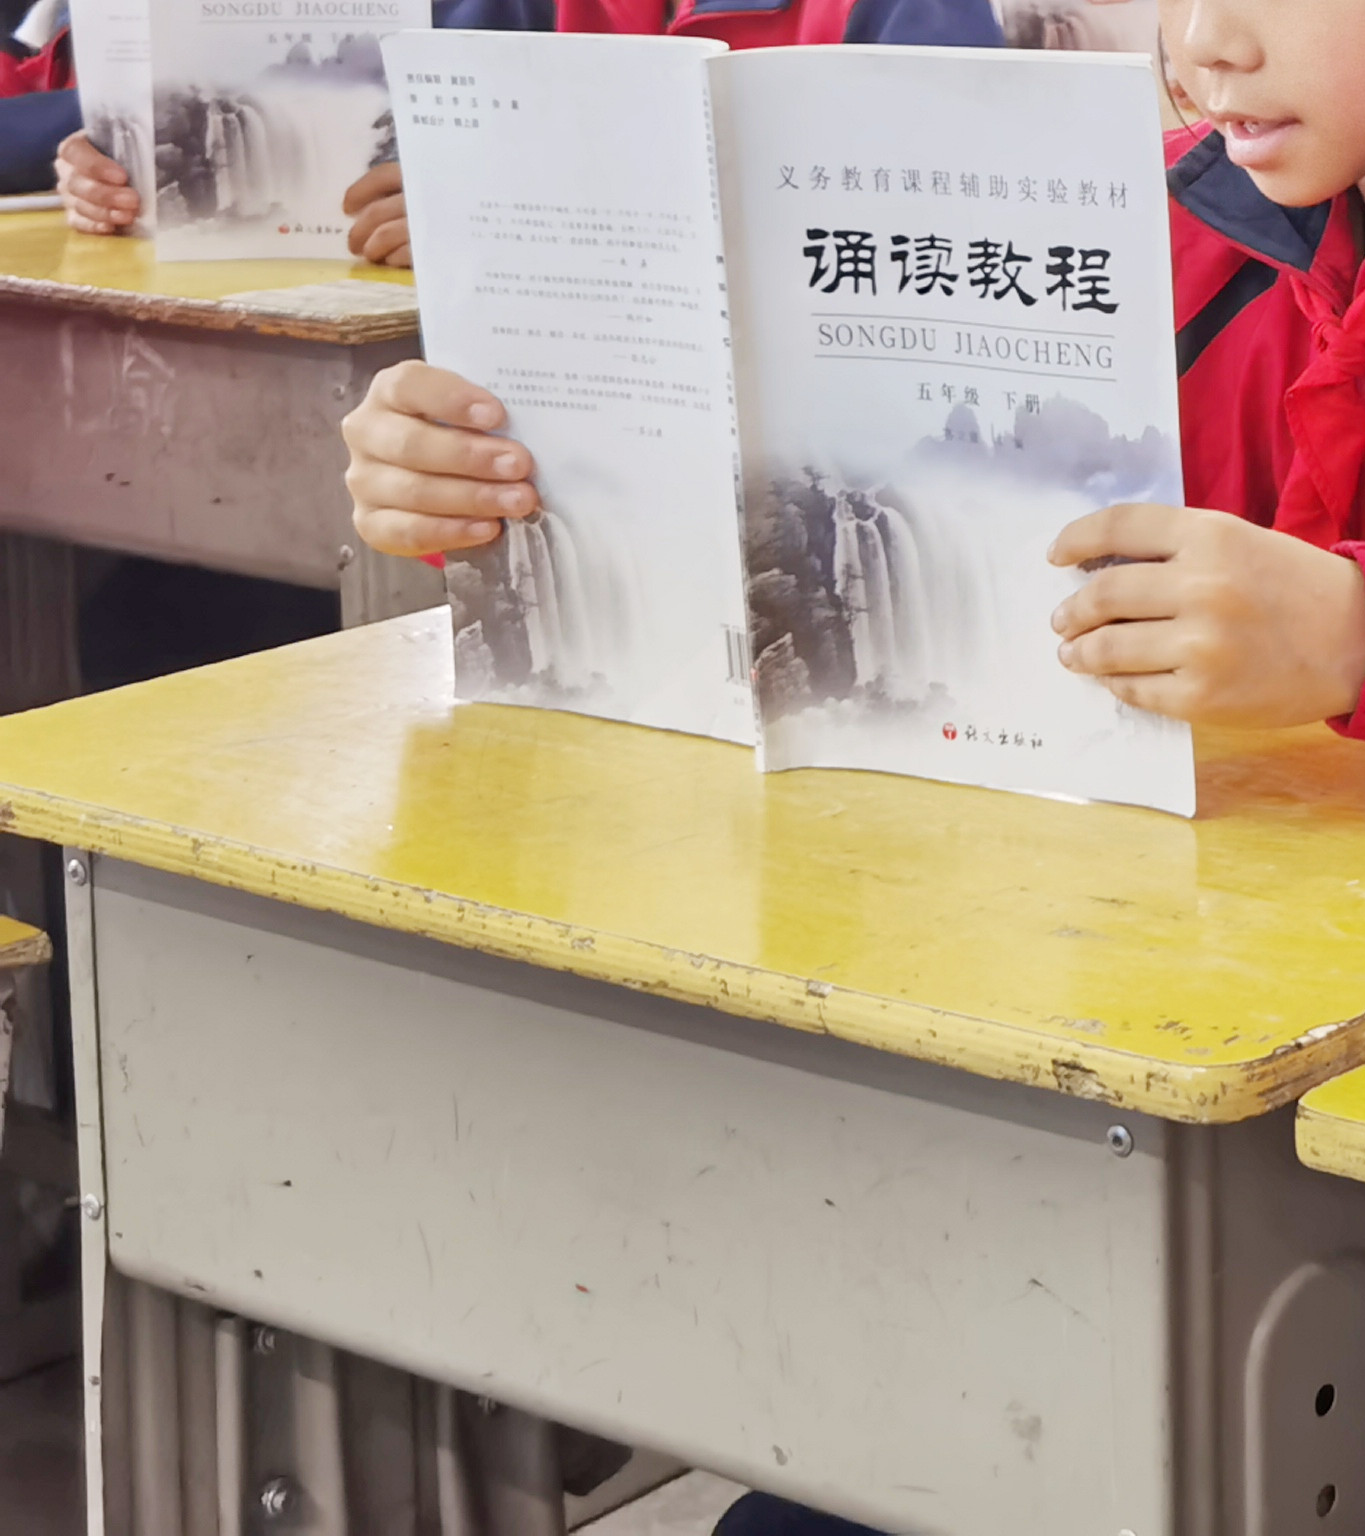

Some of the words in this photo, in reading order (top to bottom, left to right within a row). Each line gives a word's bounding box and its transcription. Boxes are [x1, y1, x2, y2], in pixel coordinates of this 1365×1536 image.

[201, 1, 283, 16] SONGDU
[295, 1, 400, 16] JIAOCHENG
[775, 164, 1131, 209] 义务教育课程辅助实验教材
[802, 227, 1121, 314] 诵读教程
[817, 322, 938, 352] SONGDU
[954, 329, 1115, 369] JIAOCHENG
[917, 382, 981, 407] 五年级
[1004, 391, 1041, 415] 下册
